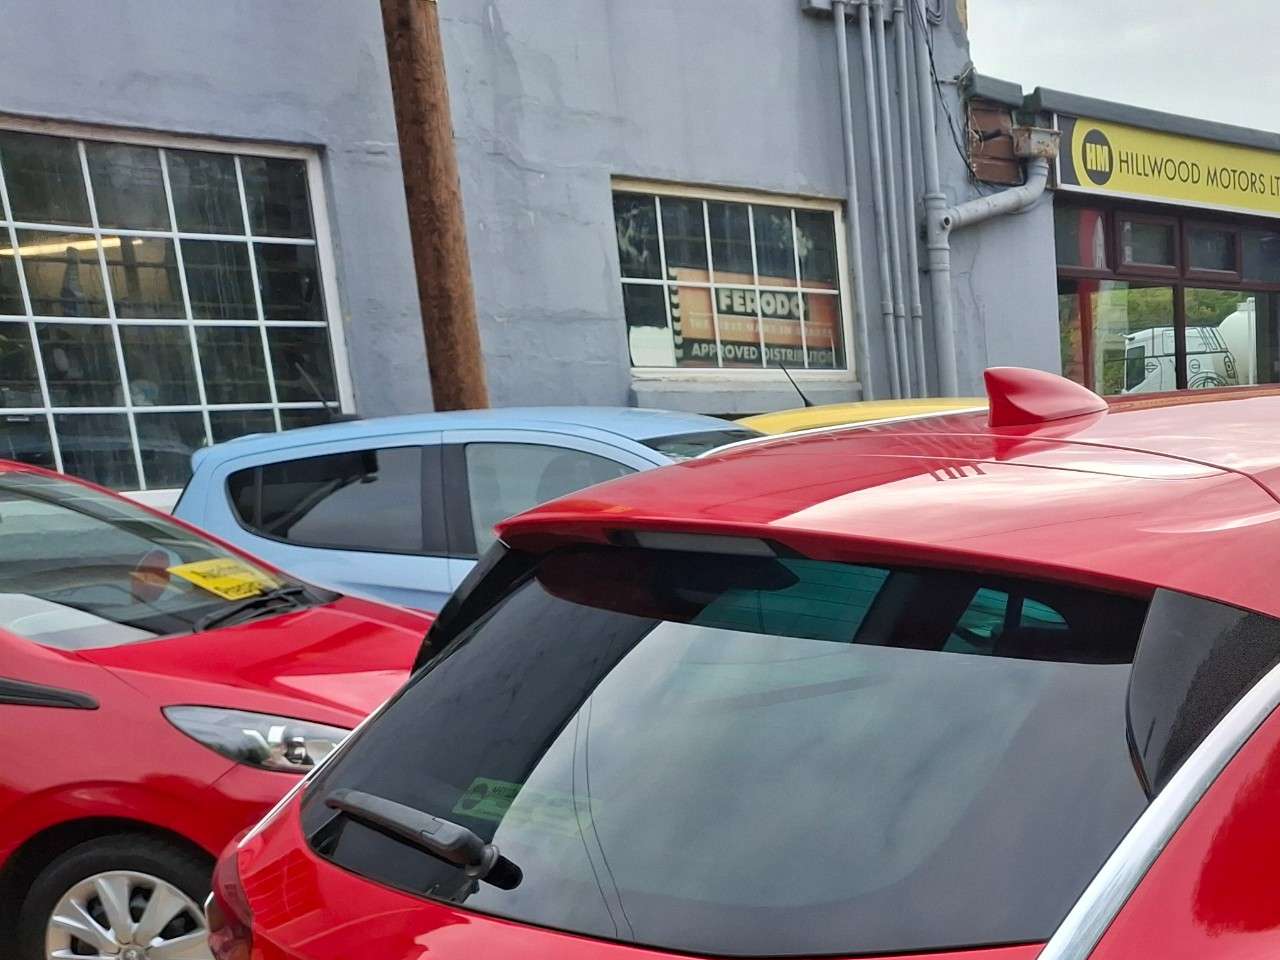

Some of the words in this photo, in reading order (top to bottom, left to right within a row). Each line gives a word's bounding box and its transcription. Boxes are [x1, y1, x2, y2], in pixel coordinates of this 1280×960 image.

[1085, 142, 1110, 172] HM
[1119, 151, 1200, 184] HILLWOOD
[1206, 166, 1266, 194] MOTORS
[719, 287, 805, 317] FERODO
[691, 342, 758, 361] APPROVED
